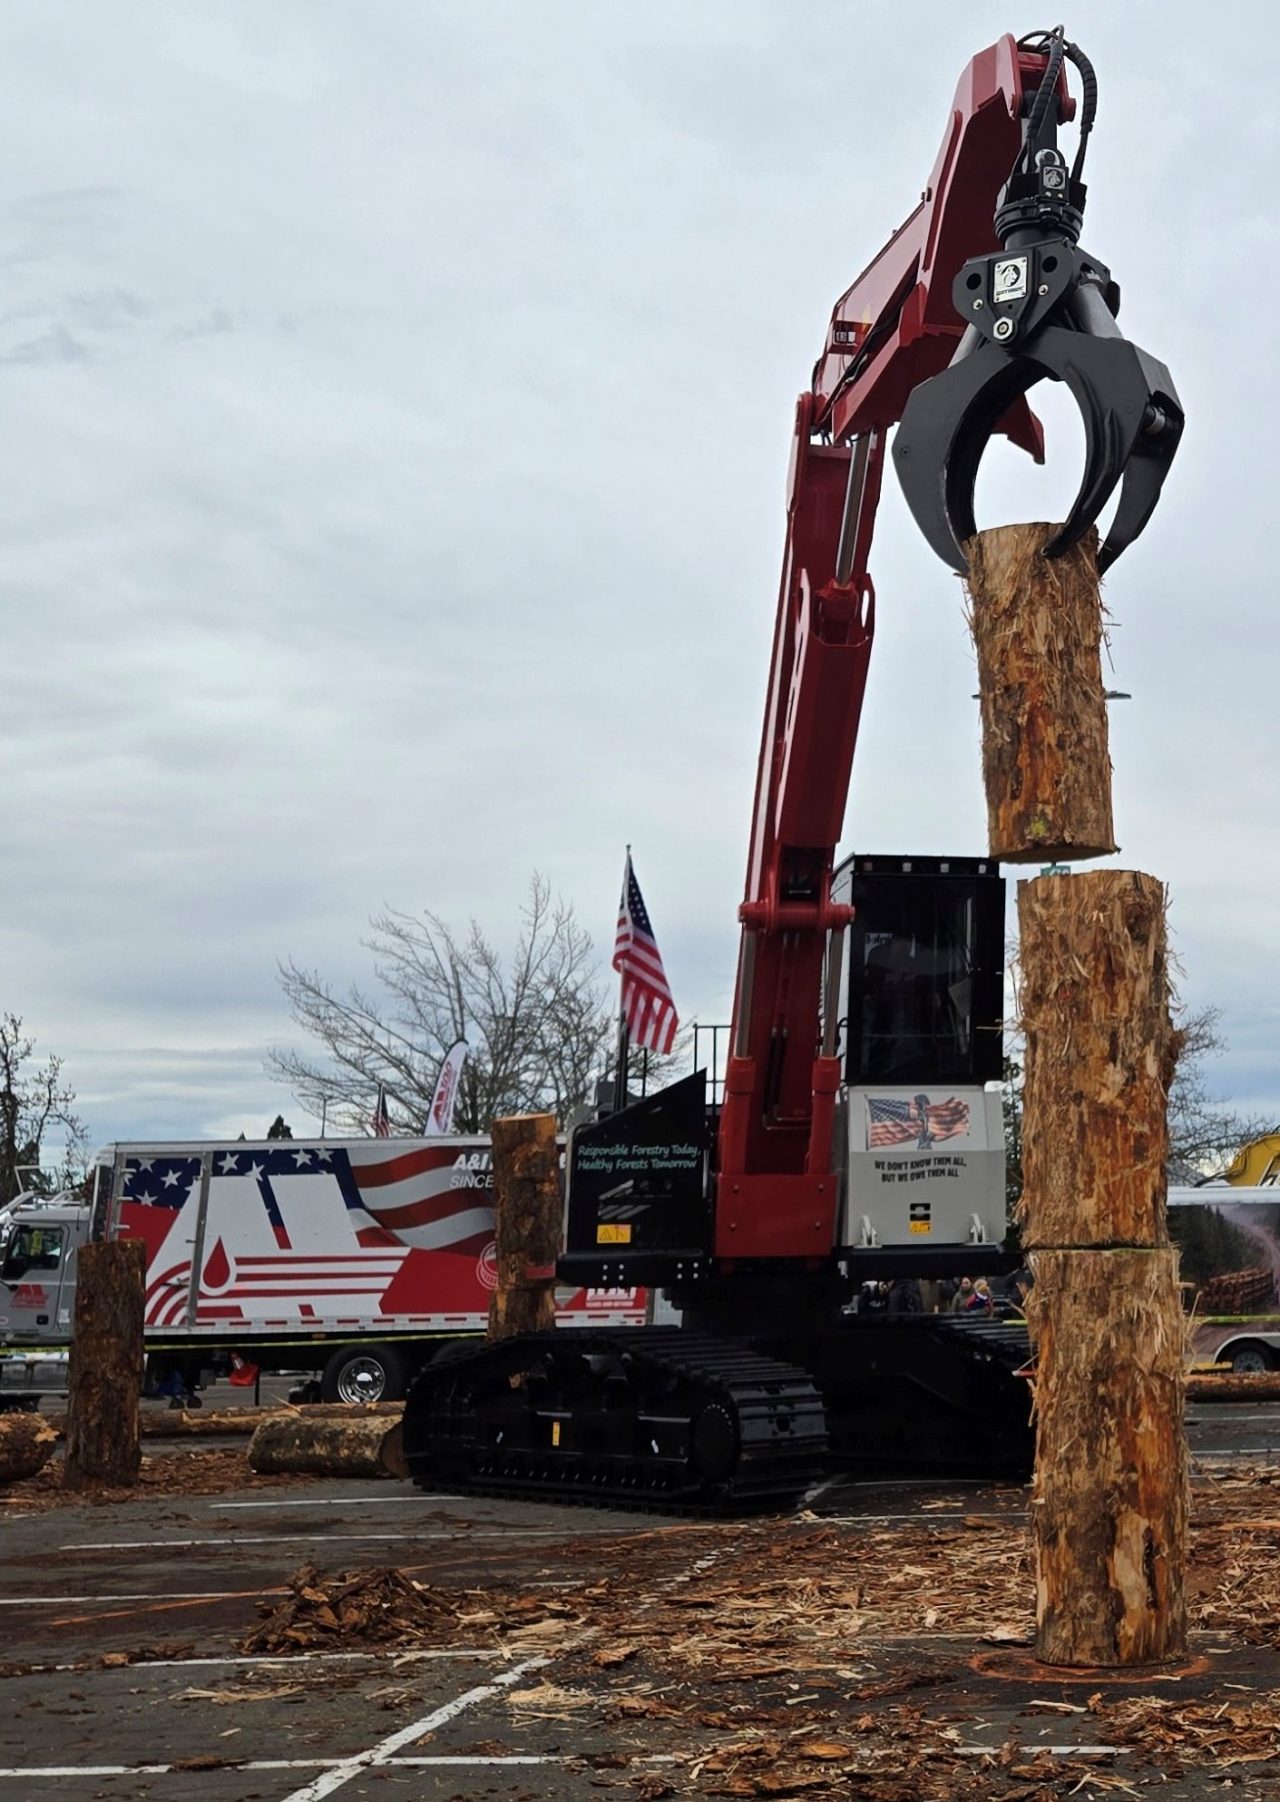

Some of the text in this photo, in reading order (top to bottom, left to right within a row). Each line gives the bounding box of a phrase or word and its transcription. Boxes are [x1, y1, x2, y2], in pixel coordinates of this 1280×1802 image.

[320, 1133, 371, 1152] KOBELCO
[578, 1143, 702, 1158] Responsible Forestry Today,
[577, 1159, 613, 1173] Healthy
[616, 1159, 649, 1170] Forests
[652, 1159, 697, 1169] Tomorrow
[874, 1156, 967, 1171] WE DON'T KNOW THEM ALL,
[449, 1174, 494, 1188] SINCE
[881, 1168, 959, 1183] BUT WE OWE THEM ALL
